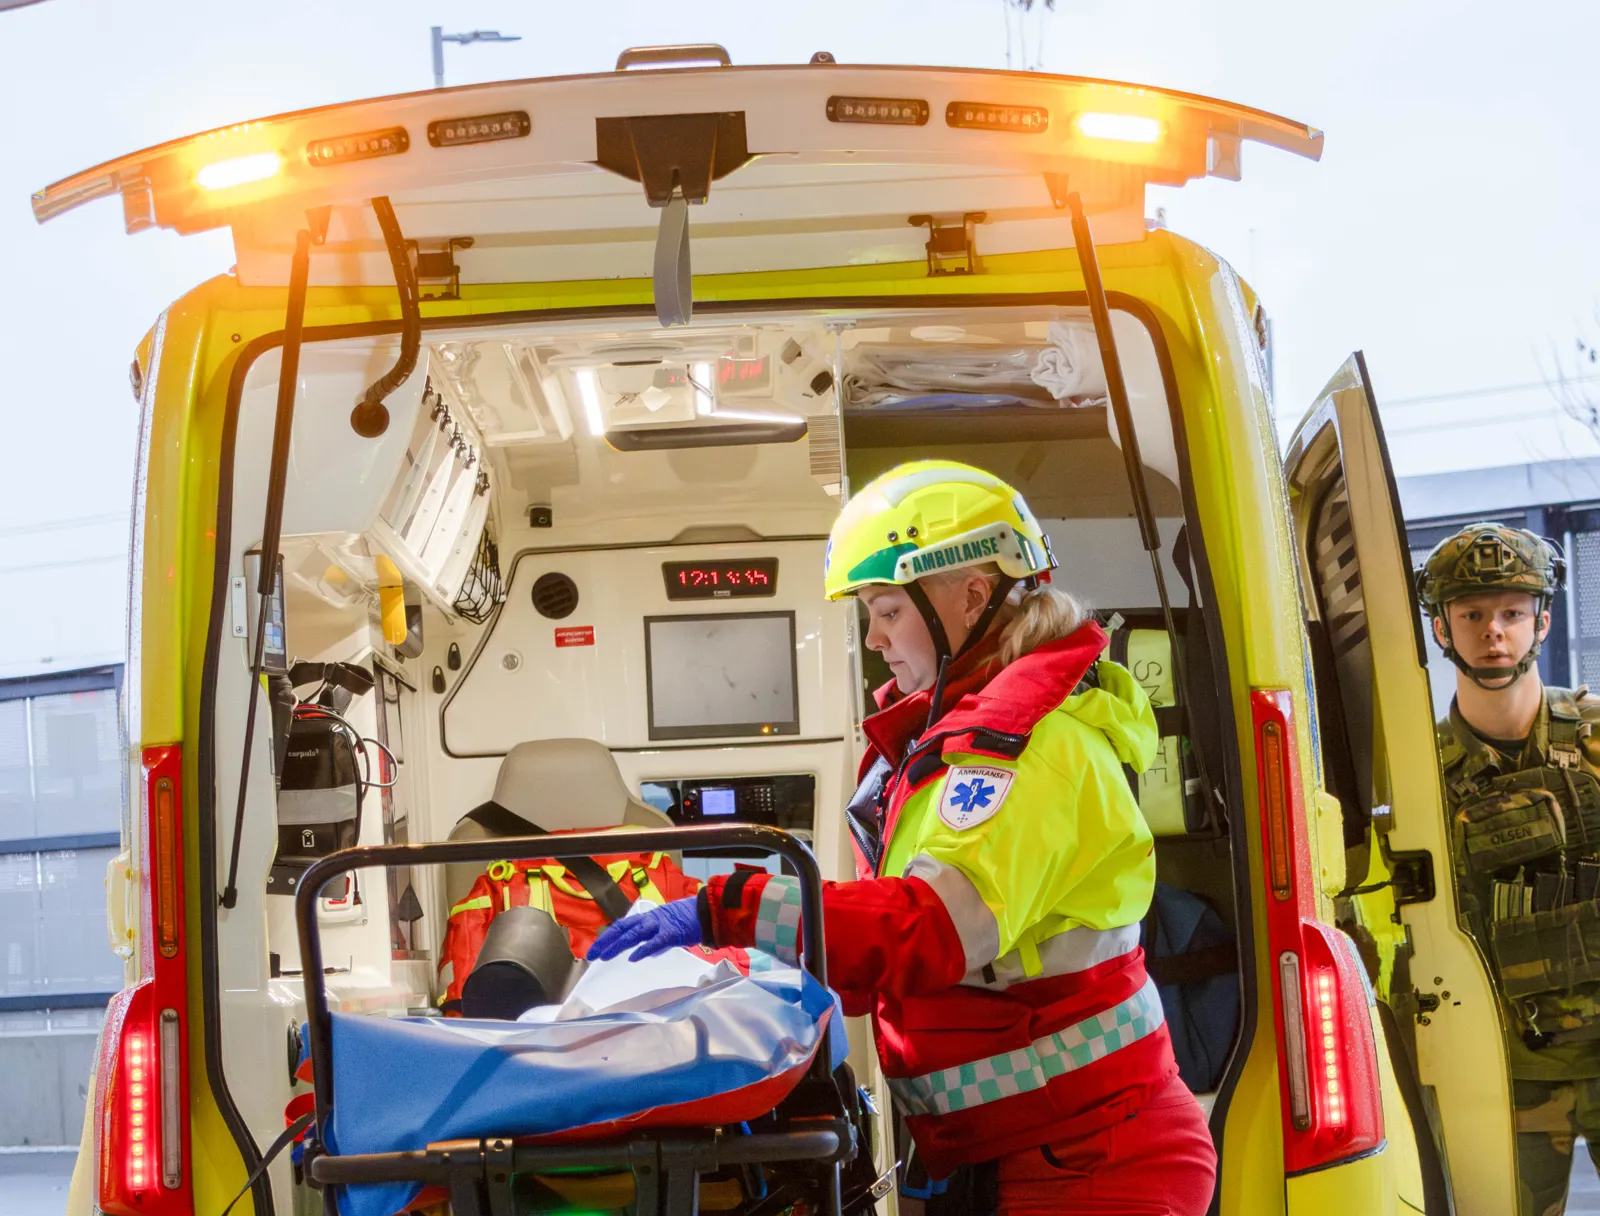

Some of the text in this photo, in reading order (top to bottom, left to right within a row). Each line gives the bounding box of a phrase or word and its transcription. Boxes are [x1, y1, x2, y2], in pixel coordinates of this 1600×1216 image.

[912, 536, 1000, 574] AMBULANSE
[957, 769, 1006, 779] AMBULANSE
[1491, 827, 1532, 845] OLSEN
